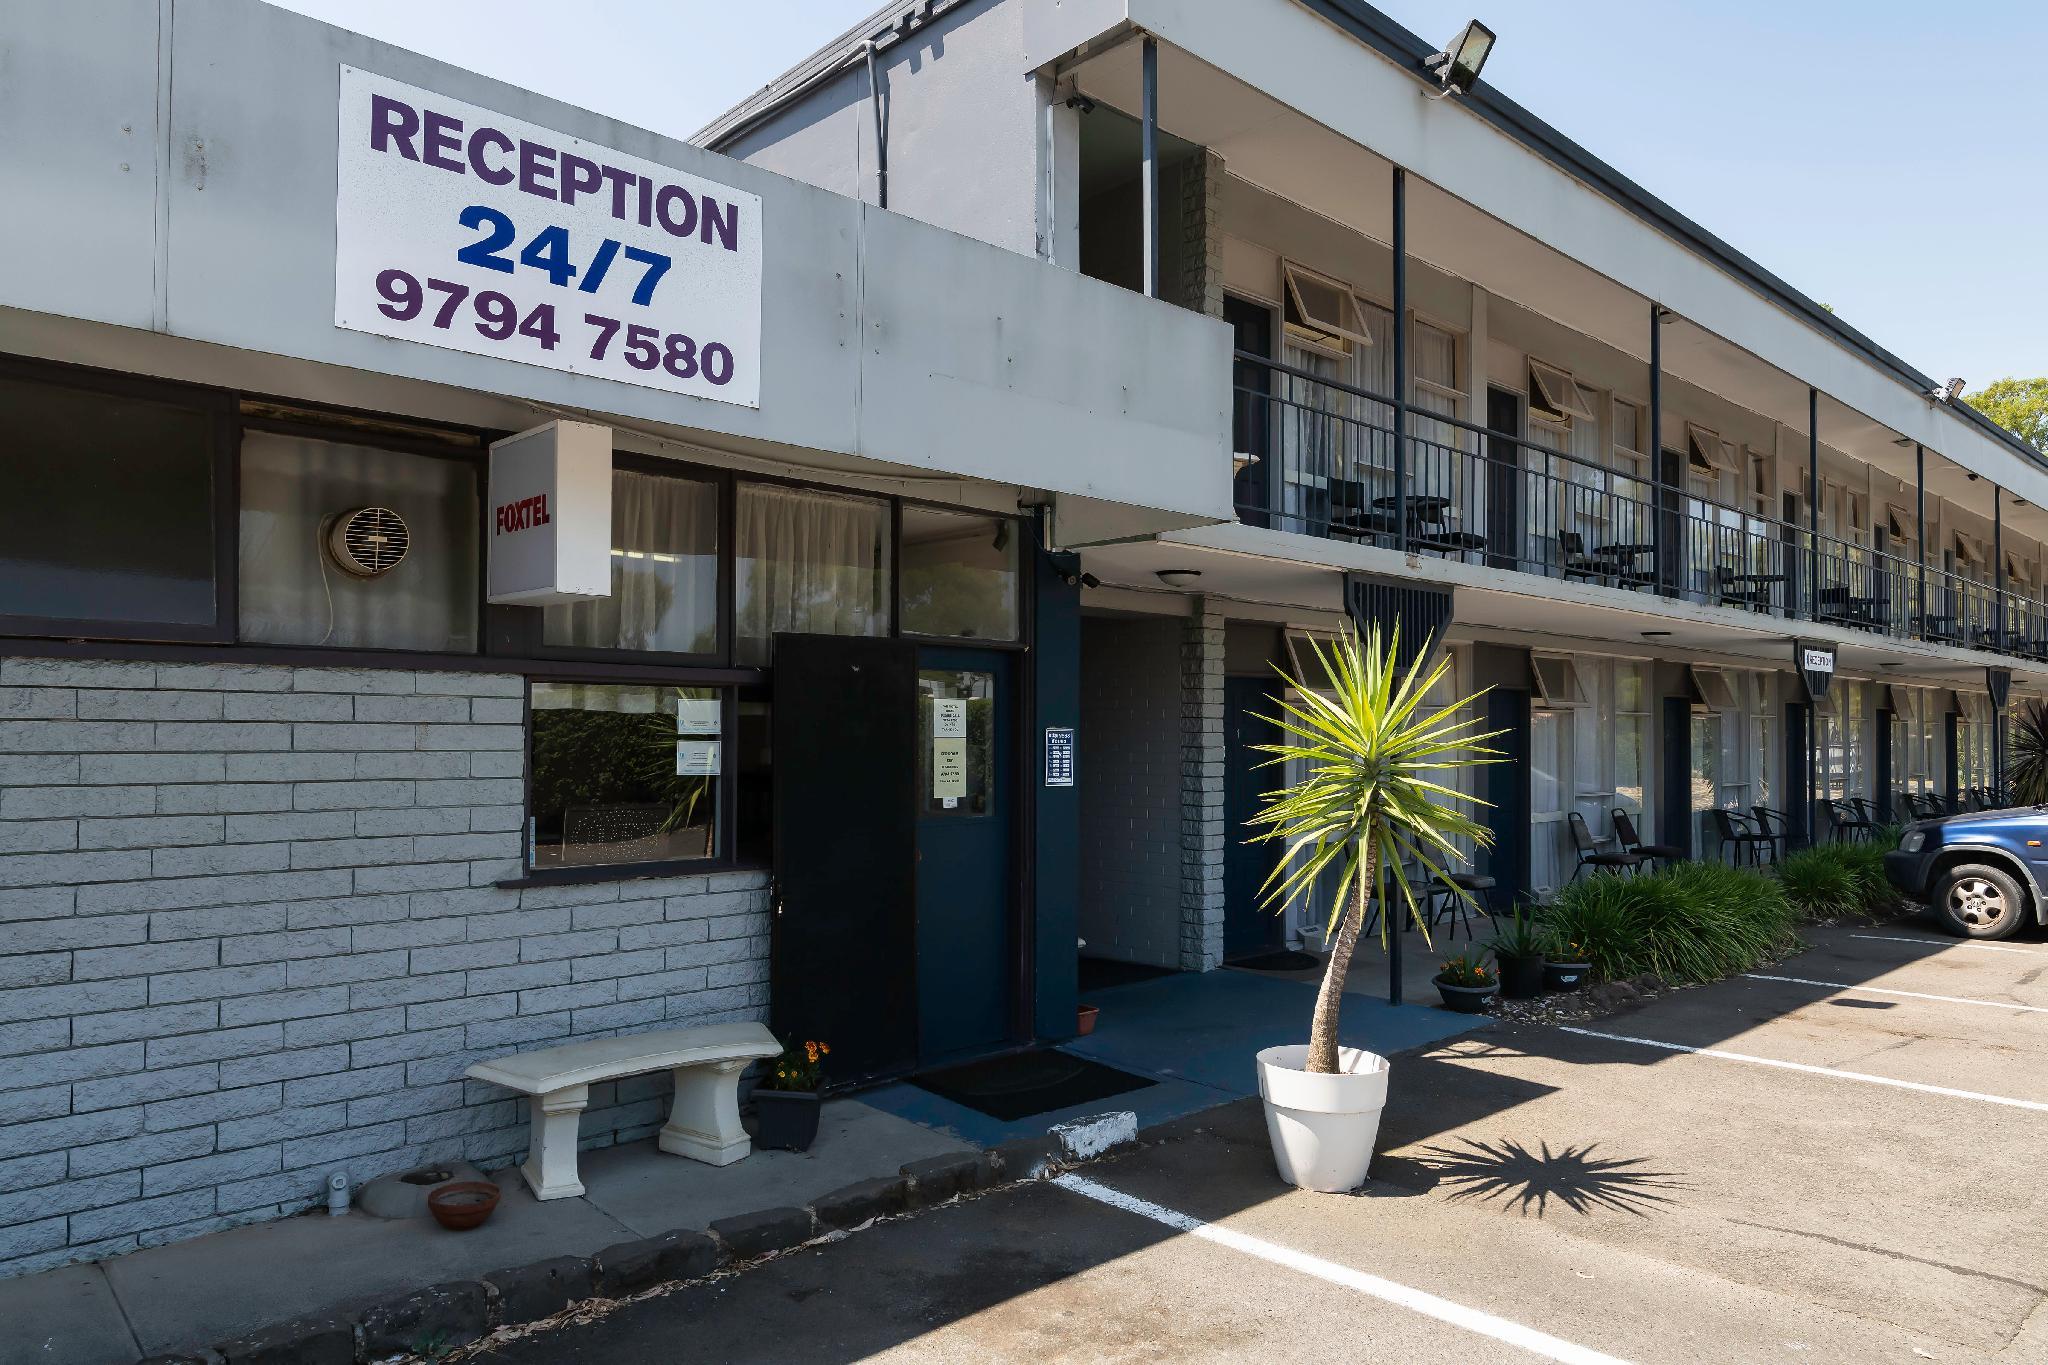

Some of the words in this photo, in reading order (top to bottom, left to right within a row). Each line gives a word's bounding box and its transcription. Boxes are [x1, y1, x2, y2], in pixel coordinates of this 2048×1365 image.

[370, 93, 739, 253] RECEPTION
[457, 205, 672, 308] 24/7
[375, 269, 561, 351] 9794
[584, 313, 734, 386] 7580
[496, 493, 550, 537] FOXTEL
